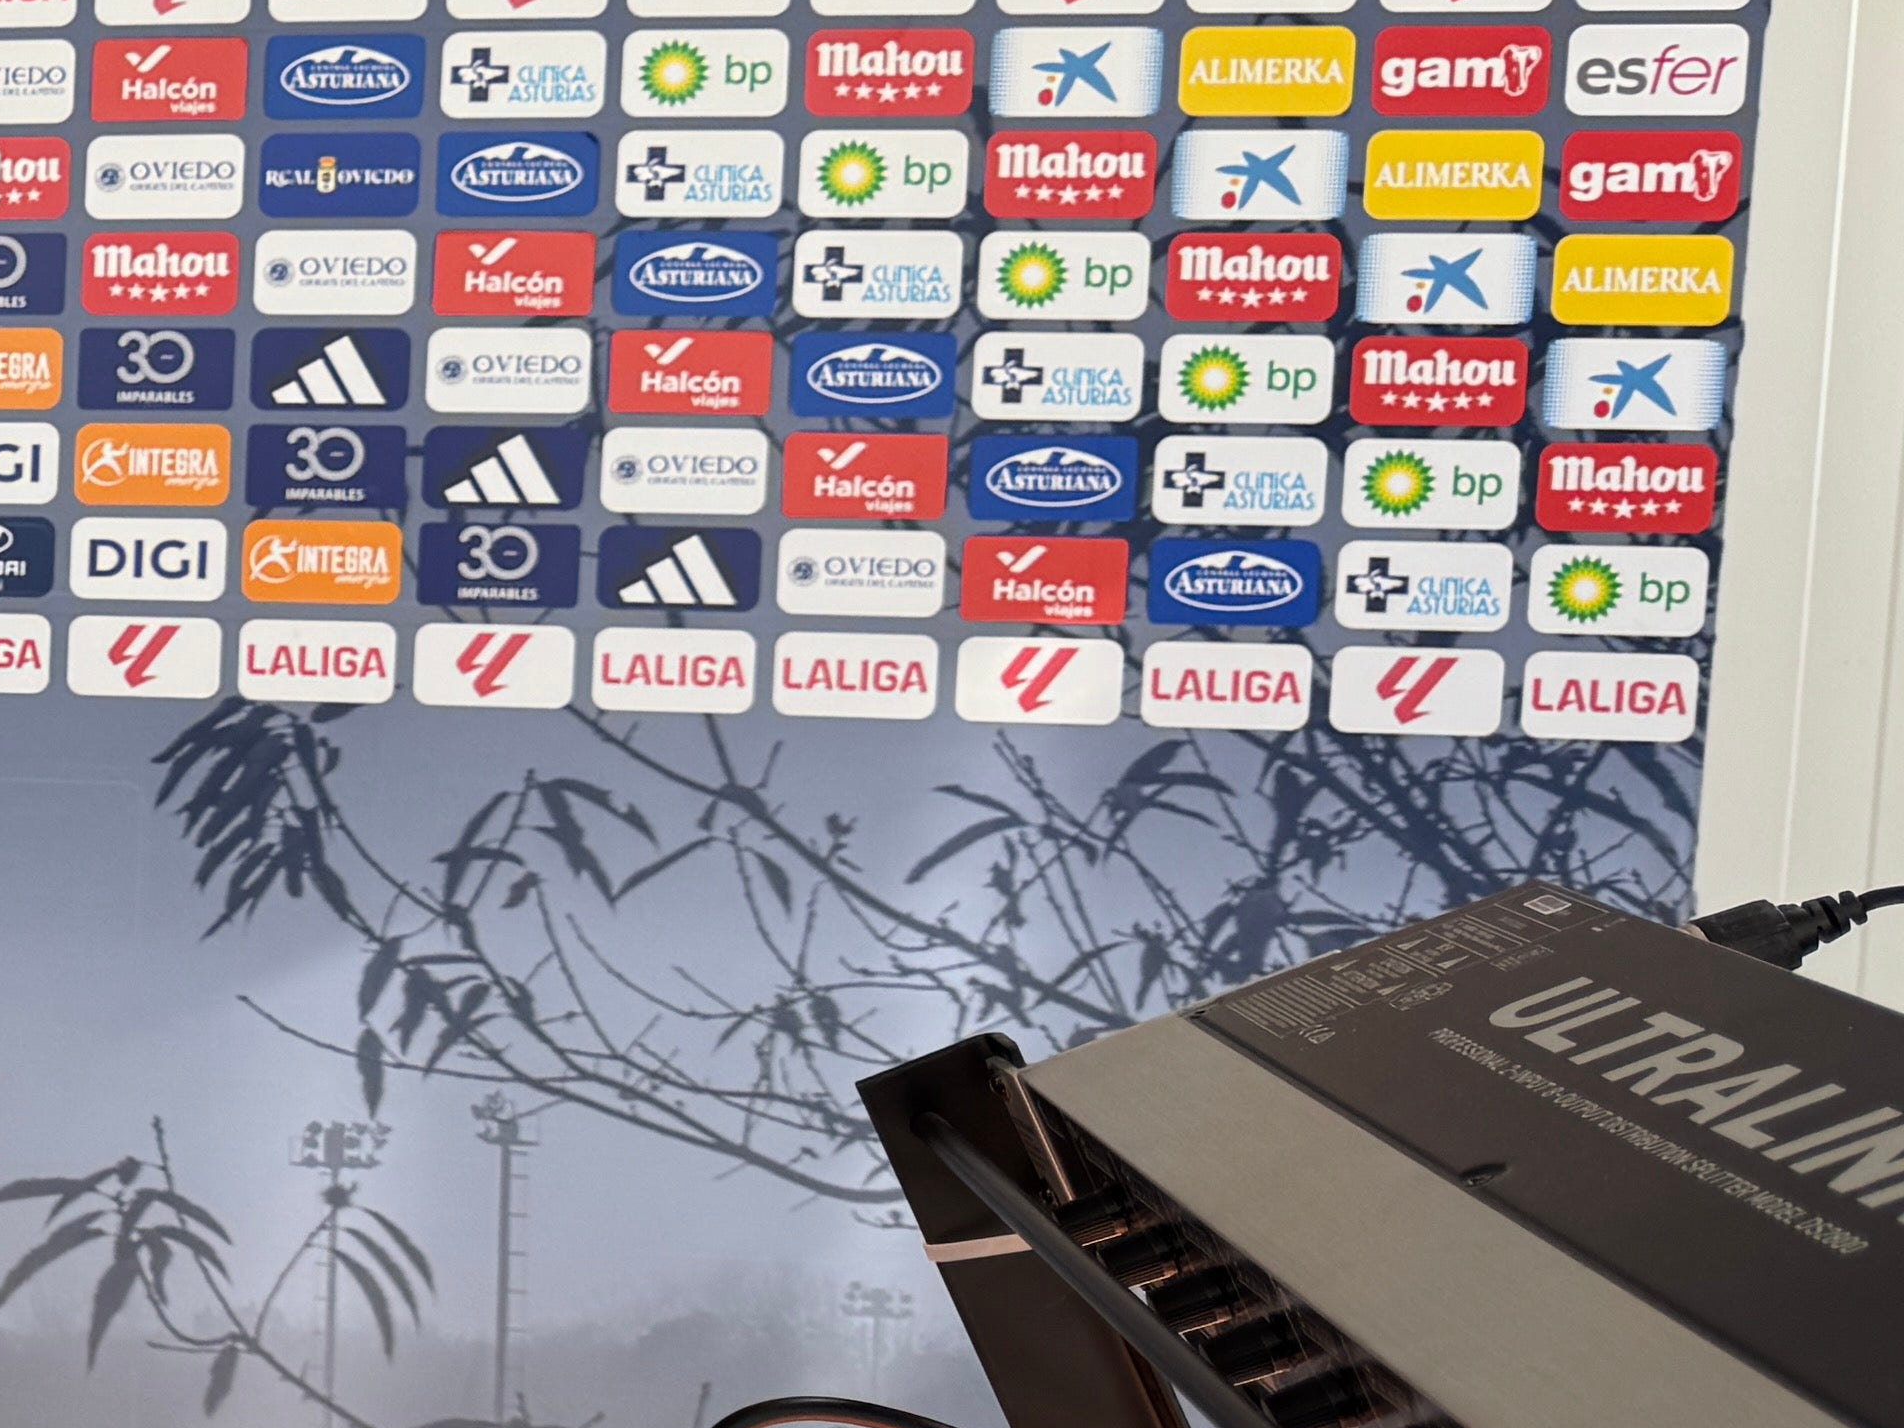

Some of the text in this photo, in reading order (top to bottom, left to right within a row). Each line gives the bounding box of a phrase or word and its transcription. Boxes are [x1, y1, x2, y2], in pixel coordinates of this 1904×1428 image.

[1574, 43, 1739, 95] esfer
[337, 169, 414, 187] OVIEDO
[903, 155, 954, 193] bp
[1373, 159, 1535, 189] ALIMERKA
[1175, 245, 1332, 283] Mahou
[641, 369, 739, 393] Halcón
[128, 447, 217, 478] INTEGRA
[1546, 455, 1708, 495] Mahou
[824, 556, 934, 577] OVIEDO
[1488, 976, 1904, 1224] ULTRALIN
